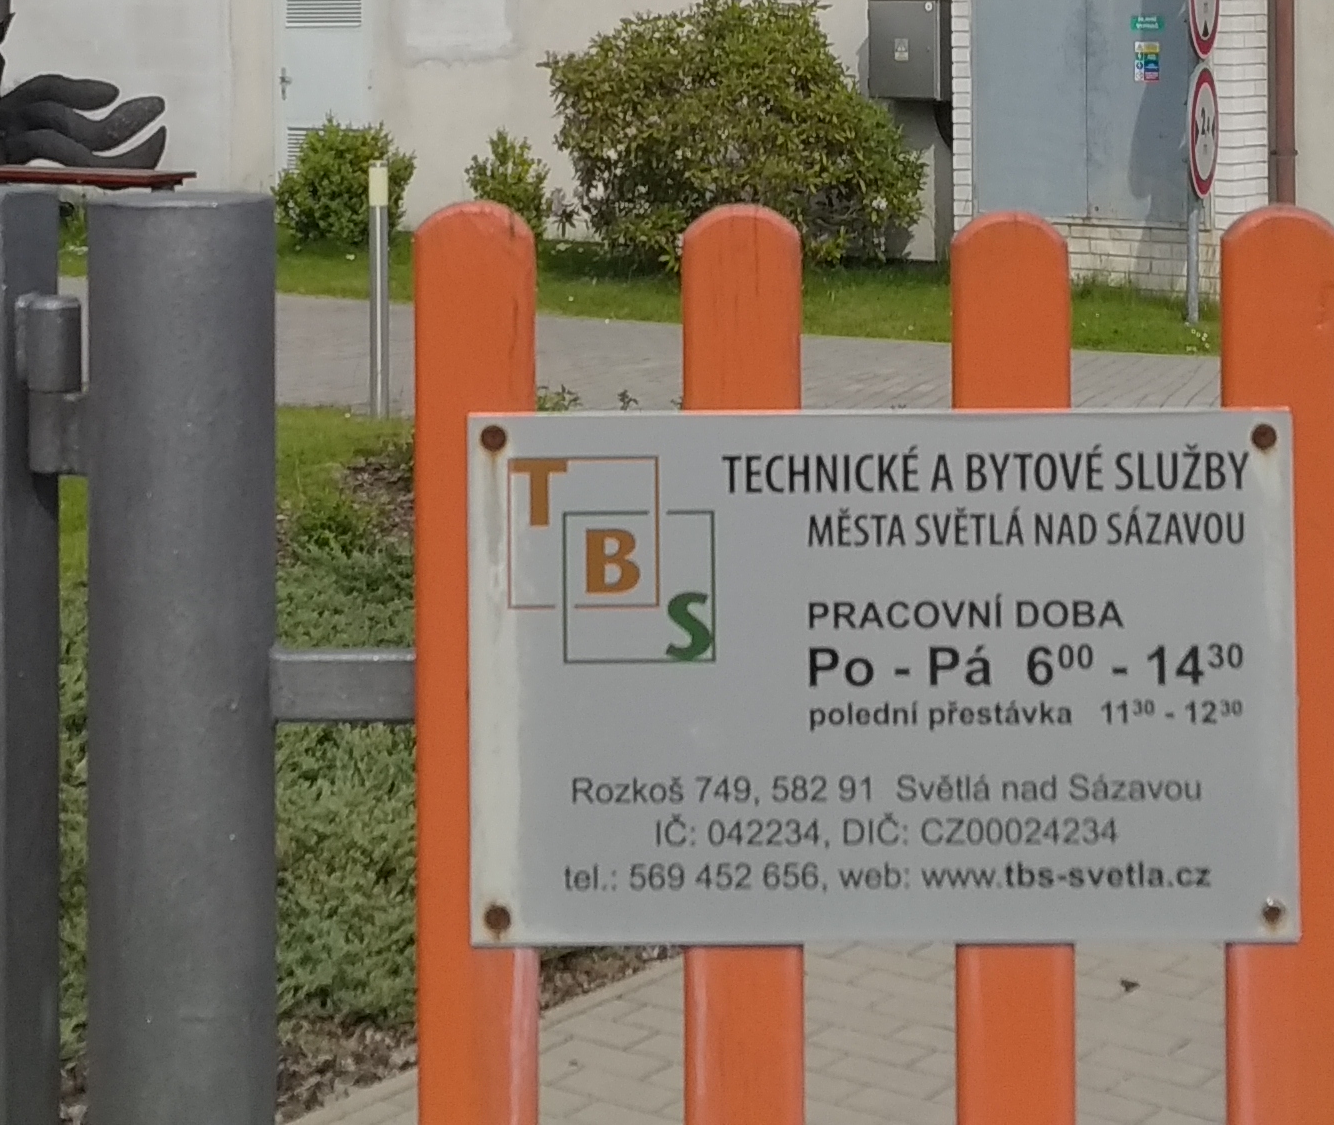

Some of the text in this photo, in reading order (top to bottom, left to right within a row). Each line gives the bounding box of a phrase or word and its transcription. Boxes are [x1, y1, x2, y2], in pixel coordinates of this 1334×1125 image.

[721, 442, 1250, 494] TECHNICKÉ A BYTOVÉ SLUŽBY
[807, 505, 1245, 548] MĚSTA SVĚTLÁ NAD SÁZAVOU
[807, 592, 1125, 630] PRACOVNÍ DOBA
[808, 646, 875, 688] Po
[928, 644, 993, 688] Pá
[809, 700, 919, 732] polední
[928, 699, 1073, 732] přestávka
[571, 772, 1202, 806] Rozkoš 749, 582 91 Světlá nad Sázavou
[655, 812, 1118, 849] IČ: 042234, DIČ: CZ00024234
[564, 859, 1211, 893] tel.: 569 452 656, web: www.tbs-svetla.cz
